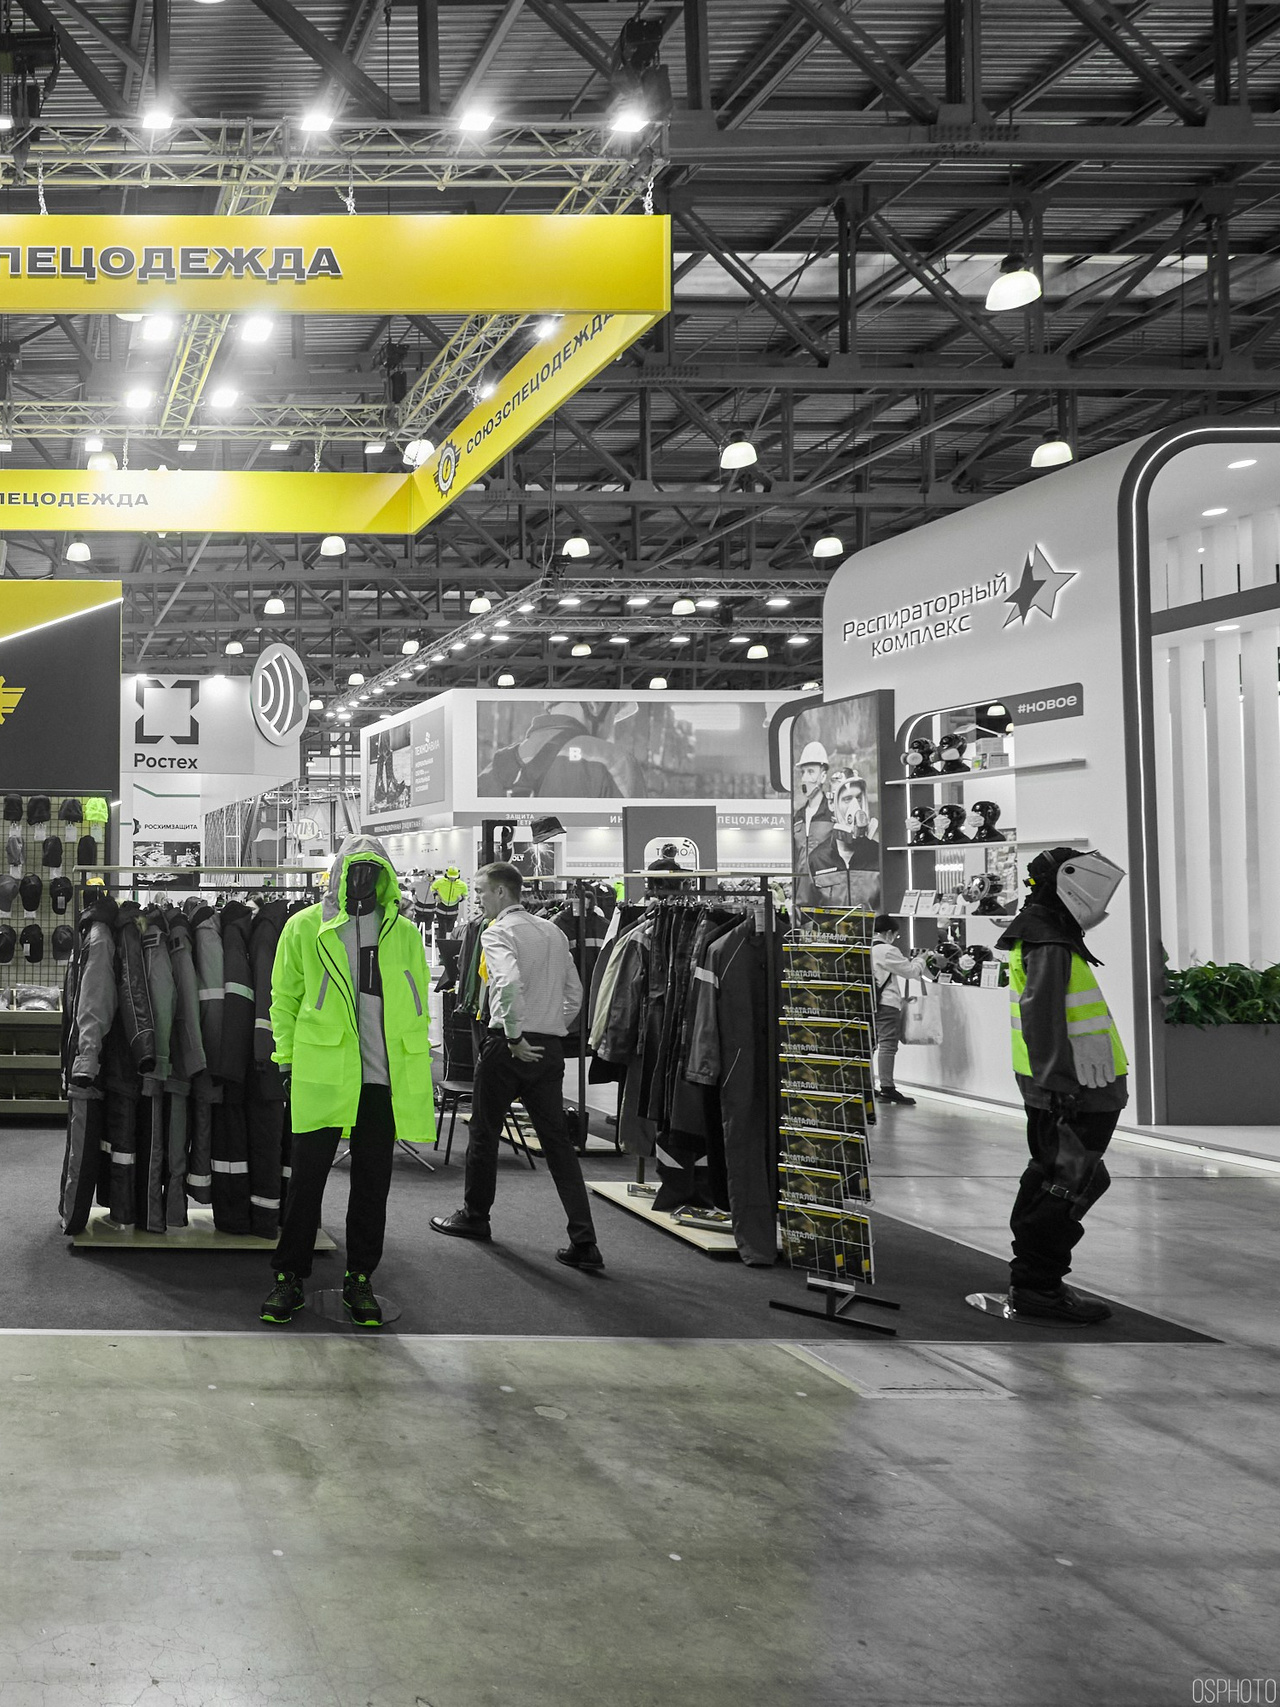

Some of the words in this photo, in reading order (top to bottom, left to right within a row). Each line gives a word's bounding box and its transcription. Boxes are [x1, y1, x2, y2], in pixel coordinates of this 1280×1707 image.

[843, 572, 1008, 642] Респираторный
[133, 752, 198, 769] Ростех
[144, 823, 198, 831] РОСХИМЗАЩИТА
[717, 815, 786, 826] ПЕЦОДЕЖДА
